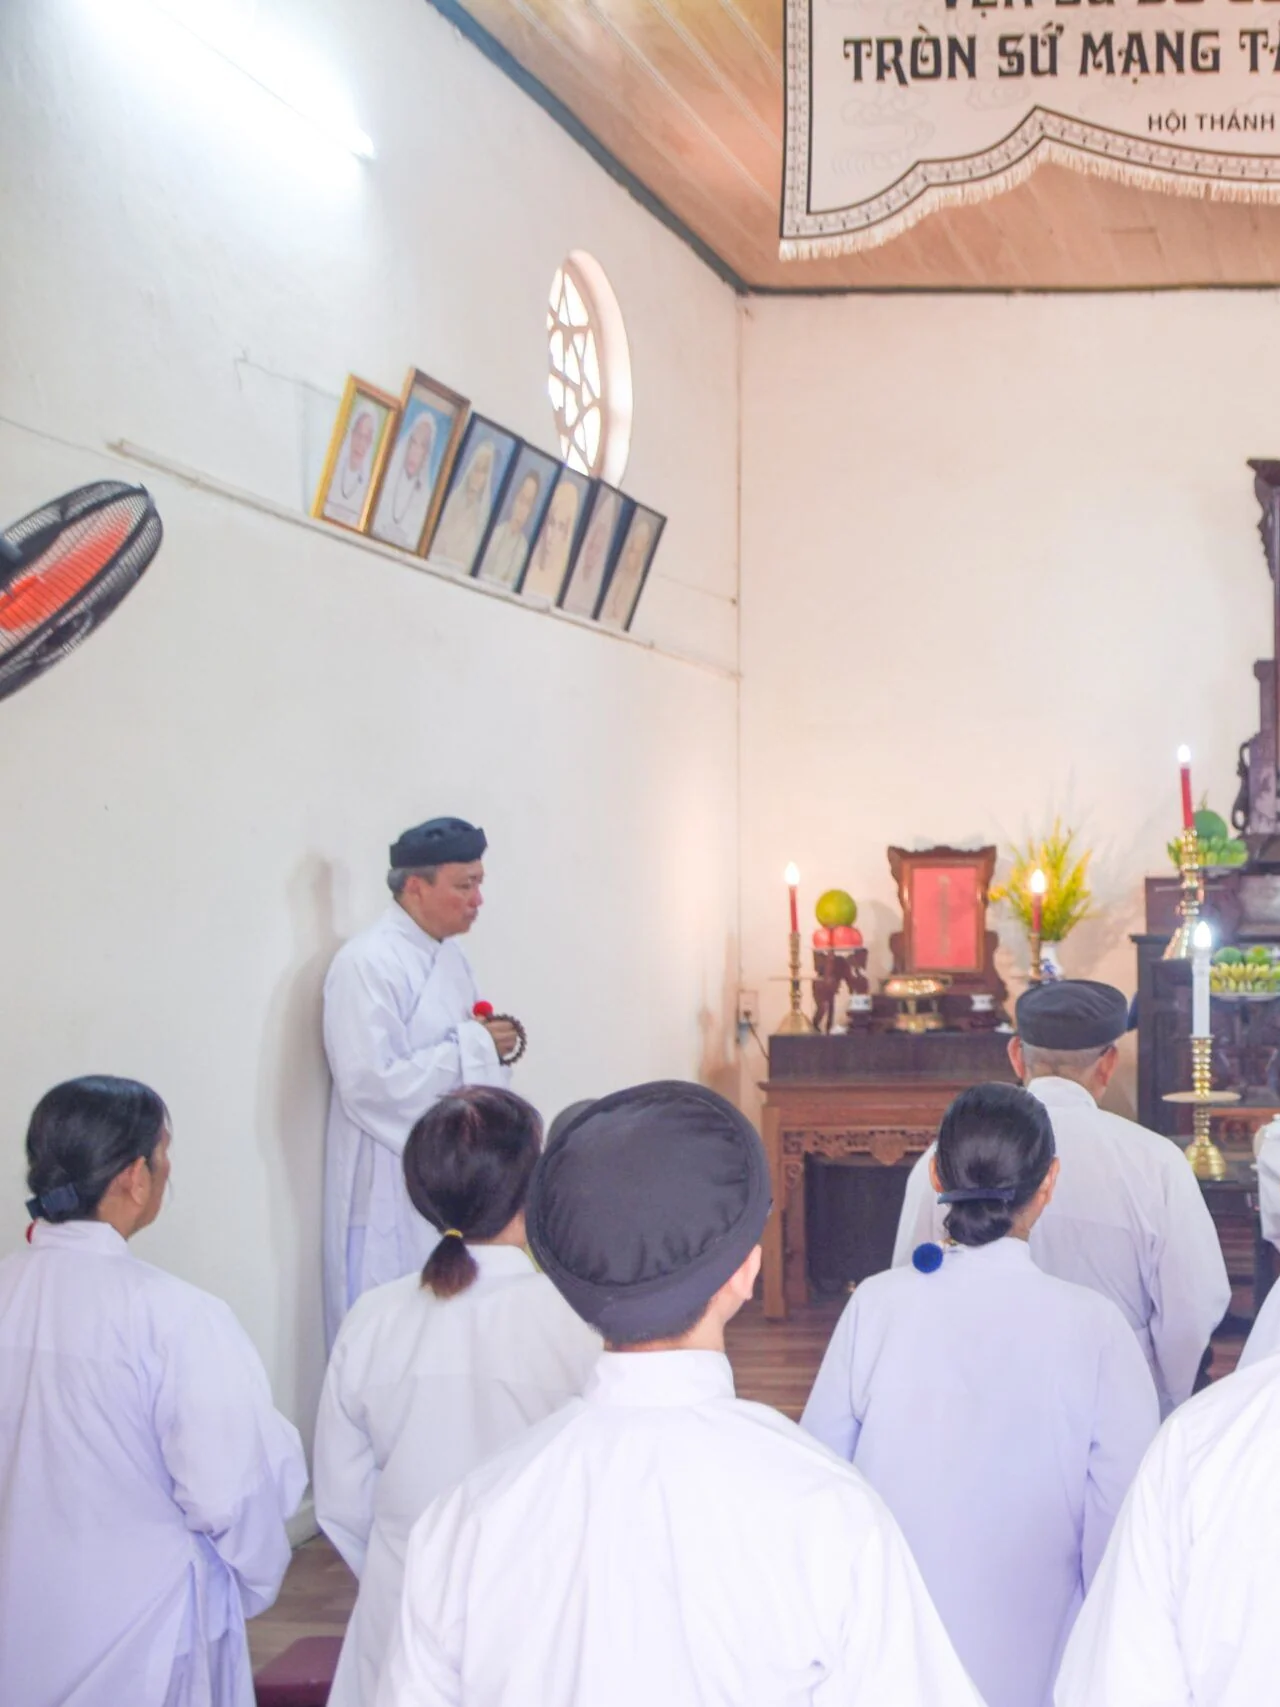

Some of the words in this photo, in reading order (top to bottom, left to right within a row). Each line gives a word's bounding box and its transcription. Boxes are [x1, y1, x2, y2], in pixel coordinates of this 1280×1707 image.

[843, 25, 977, 85] TRÒN
[997, 21, 1065, 78] SỨ
[1079, 29, 1221, 84] MẠNG
[1147, 108, 1187, 135] HỘI
[1195, 106, 1275, 132] THÁNH
